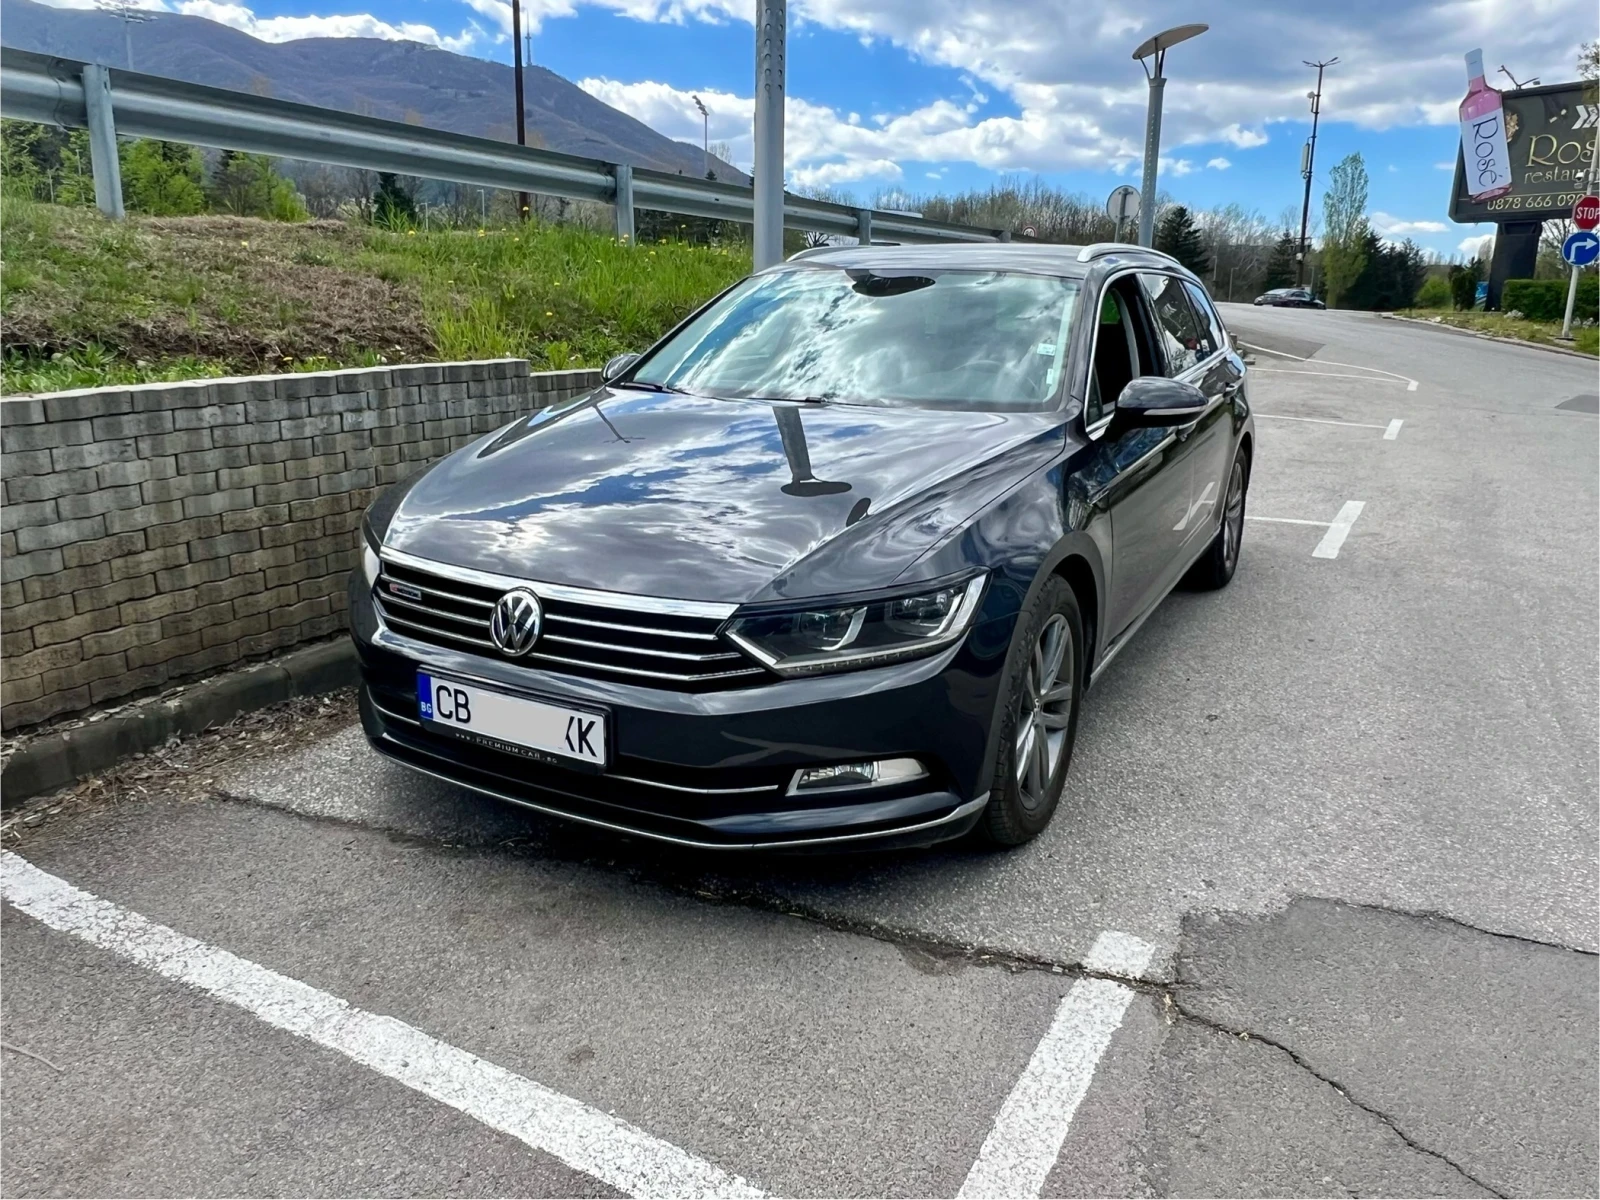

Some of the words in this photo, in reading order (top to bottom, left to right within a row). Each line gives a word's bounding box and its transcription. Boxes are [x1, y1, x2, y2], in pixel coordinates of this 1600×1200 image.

[1525, 196, 1552, 208] 666
[1576, 206, 1600, 220] STOP
[420, 701, 432, 714] BG
[435, 684, 472, 724] CB
